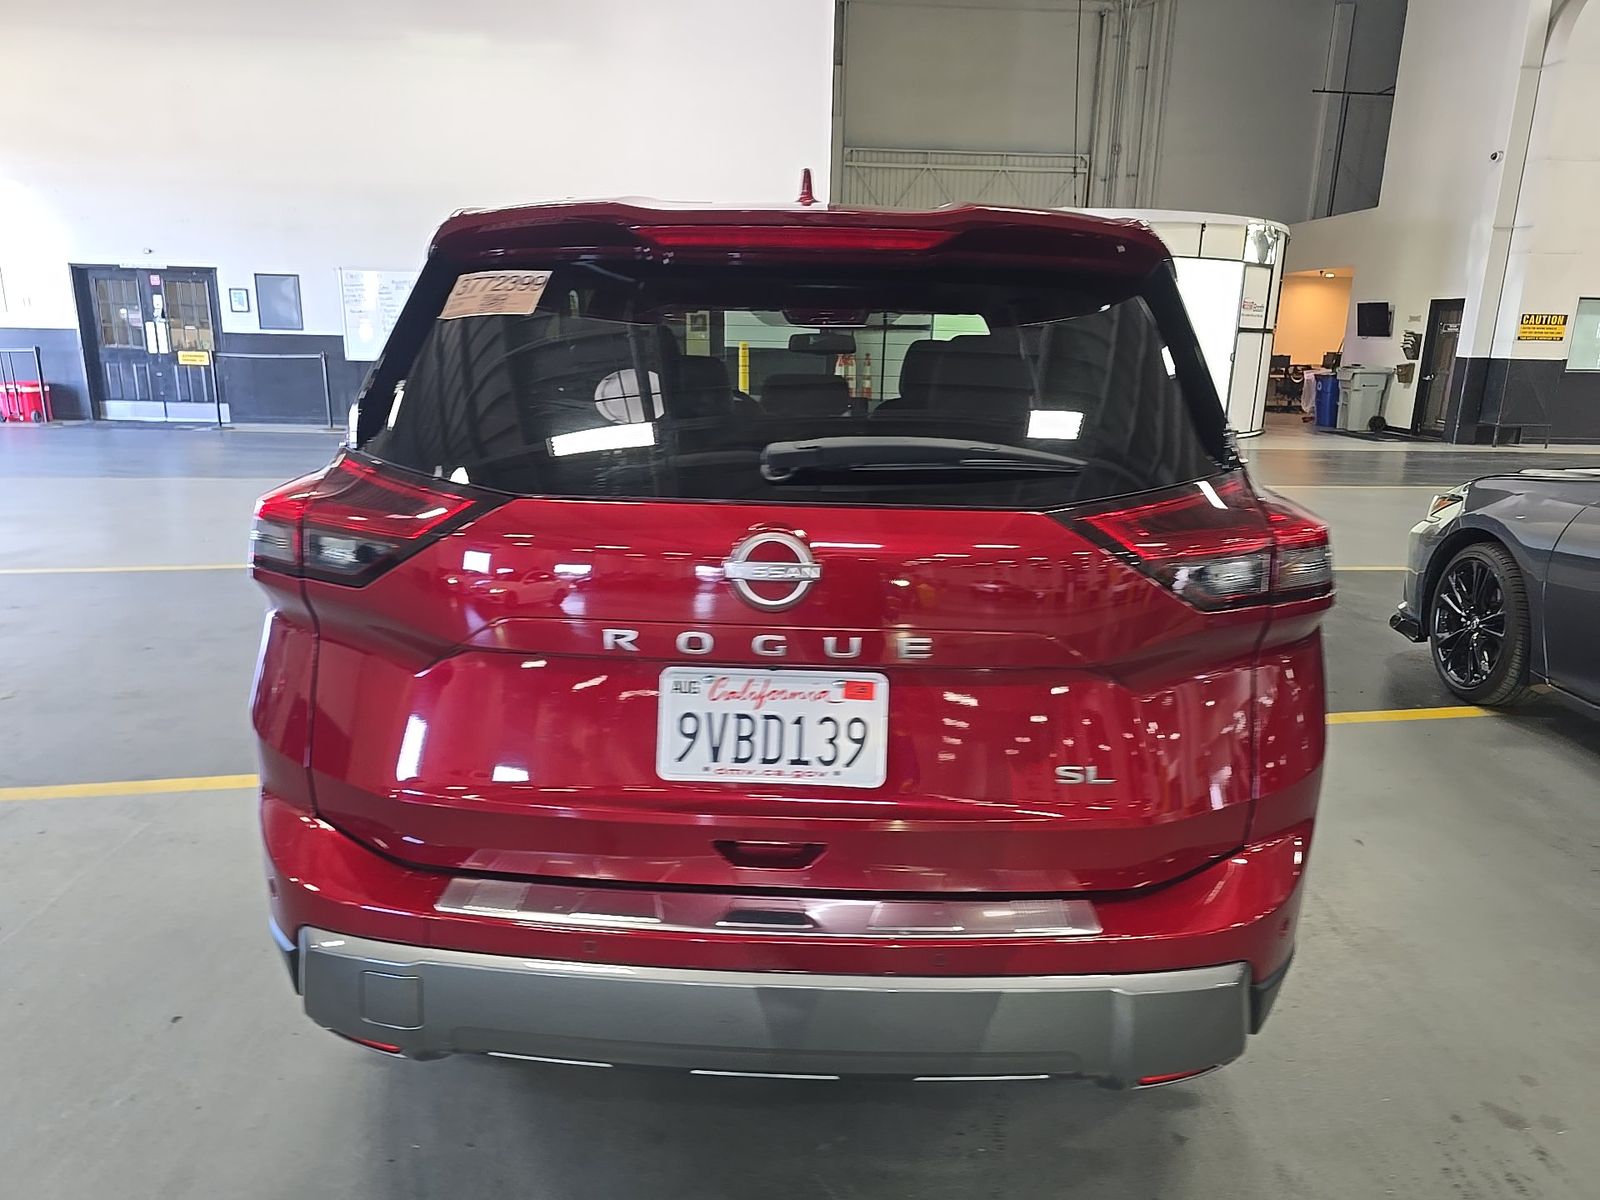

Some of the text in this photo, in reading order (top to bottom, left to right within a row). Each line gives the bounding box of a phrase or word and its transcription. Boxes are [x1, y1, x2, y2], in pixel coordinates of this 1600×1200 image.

[1522, 314, 1565, 326] CAUTION
[727, 564, 821, 580] SSAN
[602, 628, 934, 659] ROGUE
[671, 680, 701, 696] AUG
[707, 675, 830, 710] California
[674, 711, 868, 768] 9VBD139
[1054, 765, 1119, 785] SL
